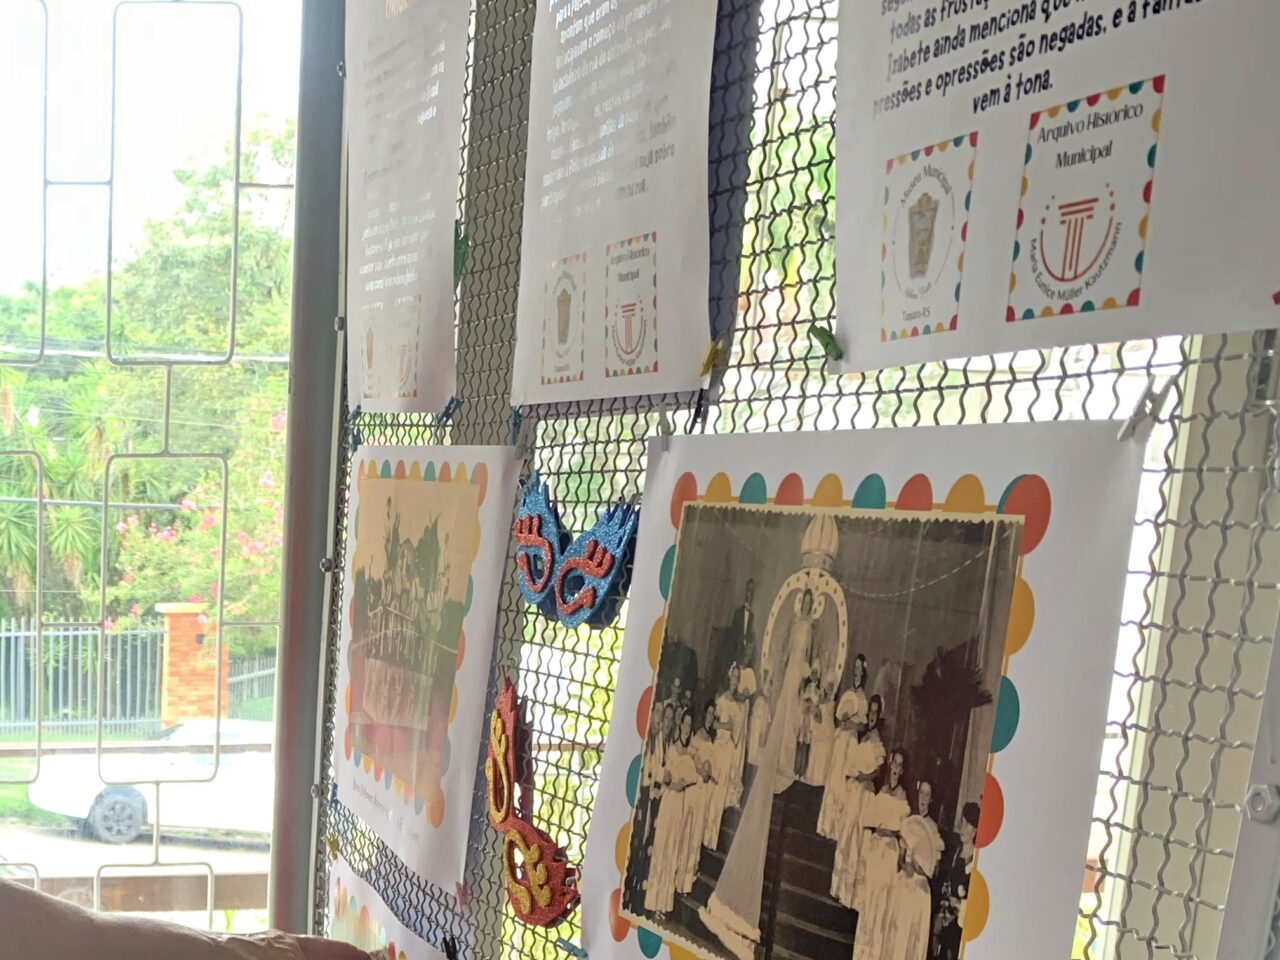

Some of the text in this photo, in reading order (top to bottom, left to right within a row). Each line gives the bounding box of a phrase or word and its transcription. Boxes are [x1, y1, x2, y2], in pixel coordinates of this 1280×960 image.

[887, 41, 930, 82] Izabete
[933, 24, 966, 58] ainda
[970, 0, 1036, 43] menciona
[890, 12, 922, 43] todas
[924, 8, 938, 27] as
[872, 80, 922, 121] pressões
[925, 78, 933, 96] e
[936, 49, 1005, 97] opressões
[1009, 33, 1035, 67] são
[1112, 7, 1123, 29] e
[1127, 0, 1137, 22] a
[973, 87, 1000, 114] vem
[1016, 69, 1053, 101] tona.
[1038, 119, 1085, 145] Arquivo
[1055, 140, 1113, 169] Municipal
